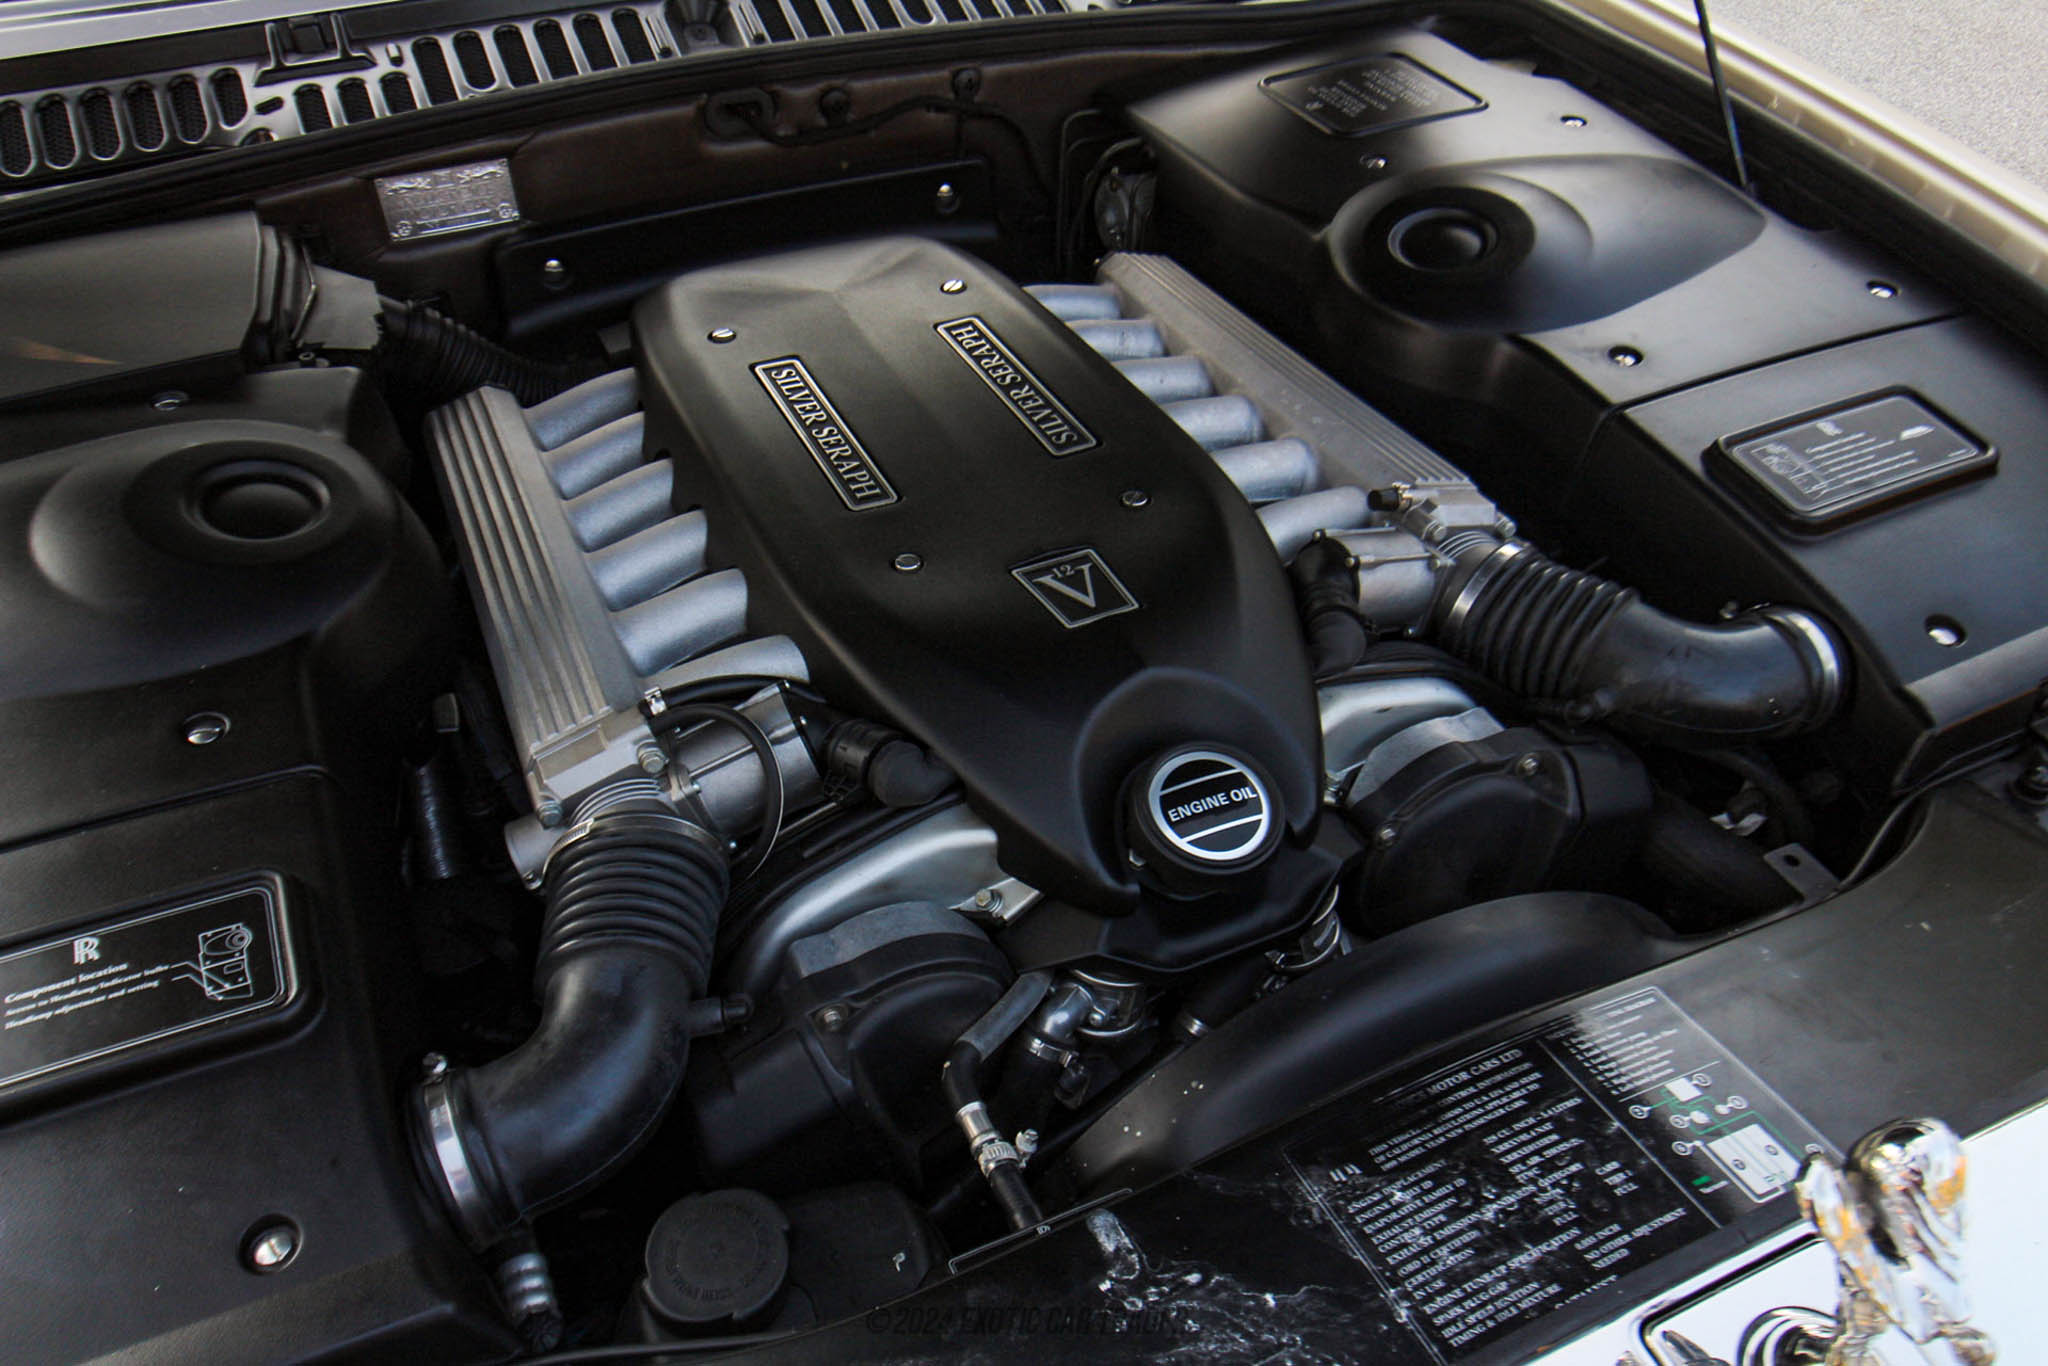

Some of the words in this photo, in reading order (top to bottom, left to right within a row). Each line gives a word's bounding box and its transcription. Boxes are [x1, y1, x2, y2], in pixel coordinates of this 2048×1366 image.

[950, 323, 1021, 391] SERAPH
[771, 365, 827, 428] SILVER
[812, 424, 882, 502] SERAPH
[1010, 387, 1078, 445] SILVER
[1167, 792, 1230, 822] ENGINE
[1229, 786, 1258, 803] OIL
[4, 977, 77, 1004] Component
[78, 962, 129, 984] location
[1427, 1071, 1470, 1094] MOTOR
[1470, 1059, 1500, 1075] CARS
[1499, 1049, 1522, 1063] LTD
[1375, 1156, 1386, 1164] OF
[1386, 1133, 1433, 1158] CALIFORNIA
[1347, 1191, 1382, 1212] ENGINE
[1382, 1158, 1447, 1195] DISPLACEMENT
[1355, 1201, 1391, 1223] ENGINE
[1421, 1180, 1433, 1189] ID
[1363, 1199, 1424, 1233] EVAPORATIVE
[1423, 1183, 1454, 1203] FAMILY
[1454, 1178, 1466, 1187] ID
[1371, 1218, 1415, 1244] EXHAUST
[1414, 1196, 1457, 1222] EMISSION
[1423, 1213, 1448, 1229] TYPE
[1386, 1235, 1436, 1264] EXHAUST
[1404, 1247, 1475, 1288] CERTIFICATION
[1423, 1287, 1465, 1313] ENGINE
[1462, 1265, 1508, 1293] TUNE-UP
[1425, 1279, 1446, 1293] USE
[1432, 1305, 1465, 1325] SPARK
[1463, 1291, 1490, 1309] PLUG
[1488, 1281, 1509, 1296] GAP
[1441, 1321, 1466, 1337] IDLE
[1583, 1249, 1601, 1261] NO
[1599, 1233, 1632, 1254] OTHER
[1449, 1323, 1487, 1347] TIMING
[1495, 1306, 1519, 1323] IDLE
[1517, 1283, 1563, 1311] MIXTURE
[1592, 1247, 1630, 1271] NEEDED
